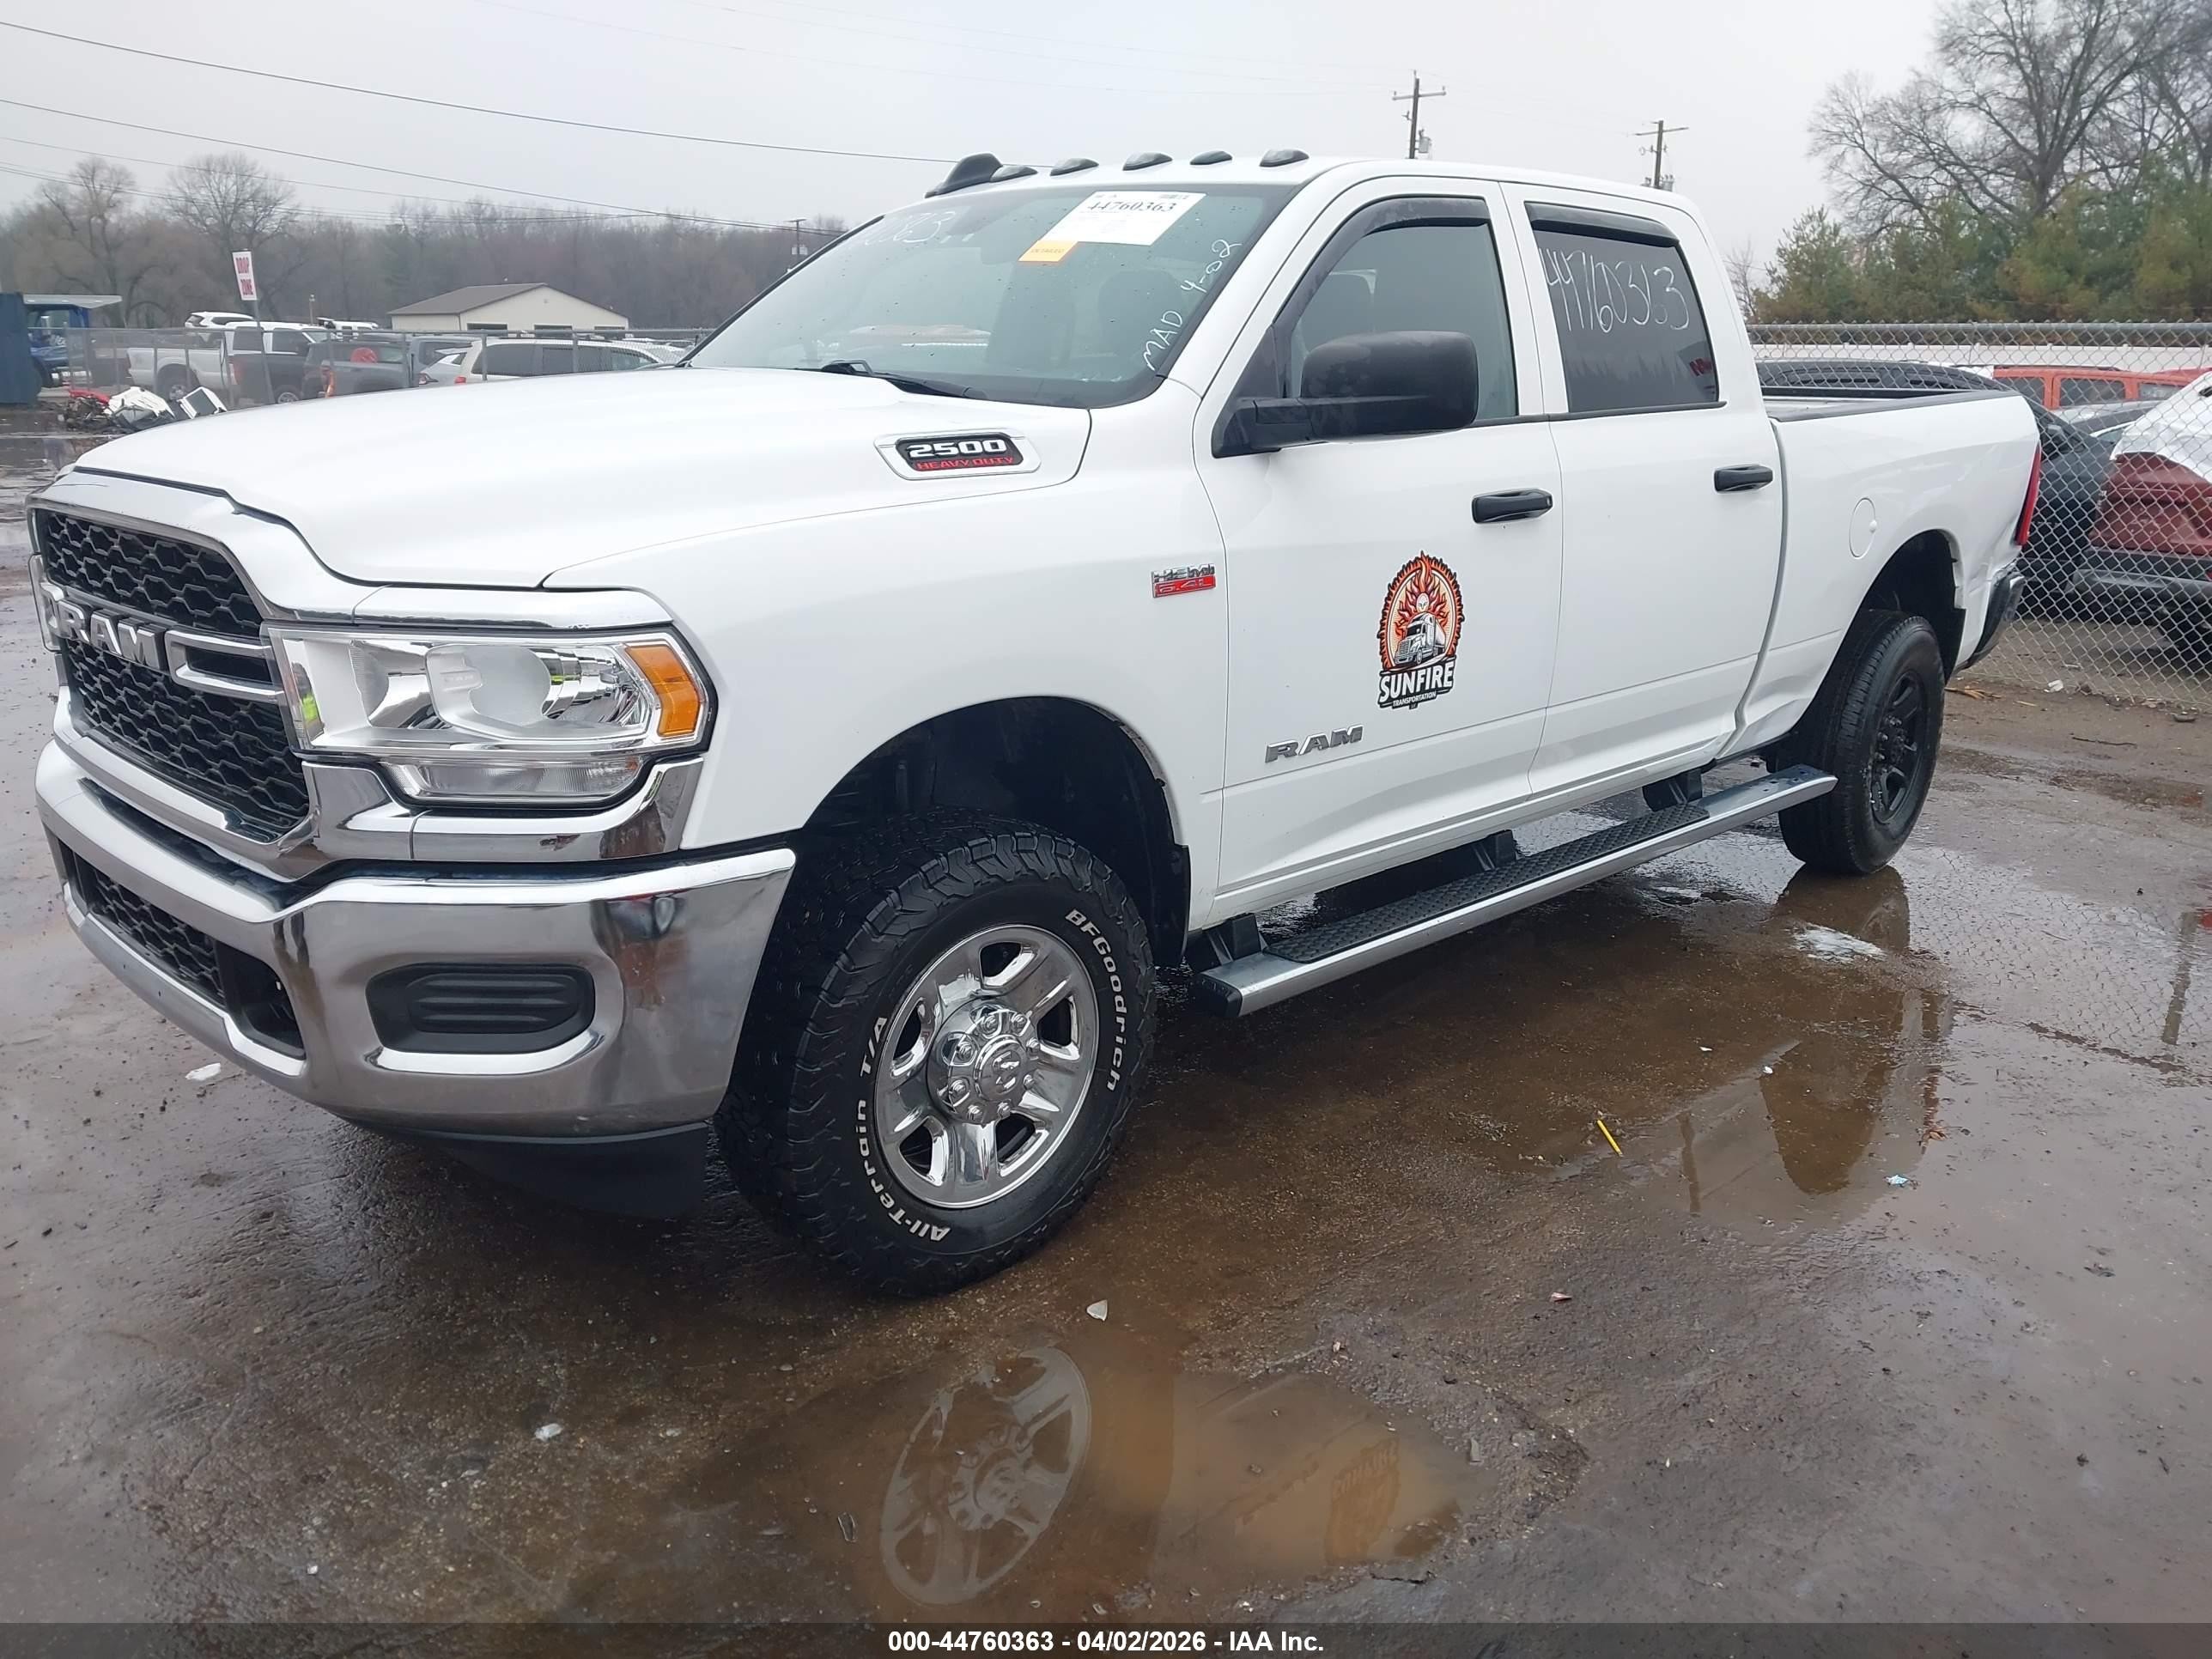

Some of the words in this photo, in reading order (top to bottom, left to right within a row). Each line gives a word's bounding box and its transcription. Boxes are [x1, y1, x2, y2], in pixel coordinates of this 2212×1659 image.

[1088, 200, 1177, 212] 44760363
[235, 257, 249, 274] DROP
[906, 439, 1007, 459] 2500
[917, 459, 971, 471] HEAVY
[973, 456, 1014, 466] DUTY
[1152, 563, 1215, 583] HEMI
[1158, 579, 1212, 593] 6.4L
[58, 600, 161, 671] RAM
[1378, 661, 1455, 703] SUNFIRE
[1392, 690, 1437, 707] TRANSPORTATION
[1265, 724, 1364, 763] RAM
[1065, 908, 1127, 1091] BFGoodrich
[860, 1017, 888, 1077] T/A
[856, 1100, 951, 1242] All-Terrain
